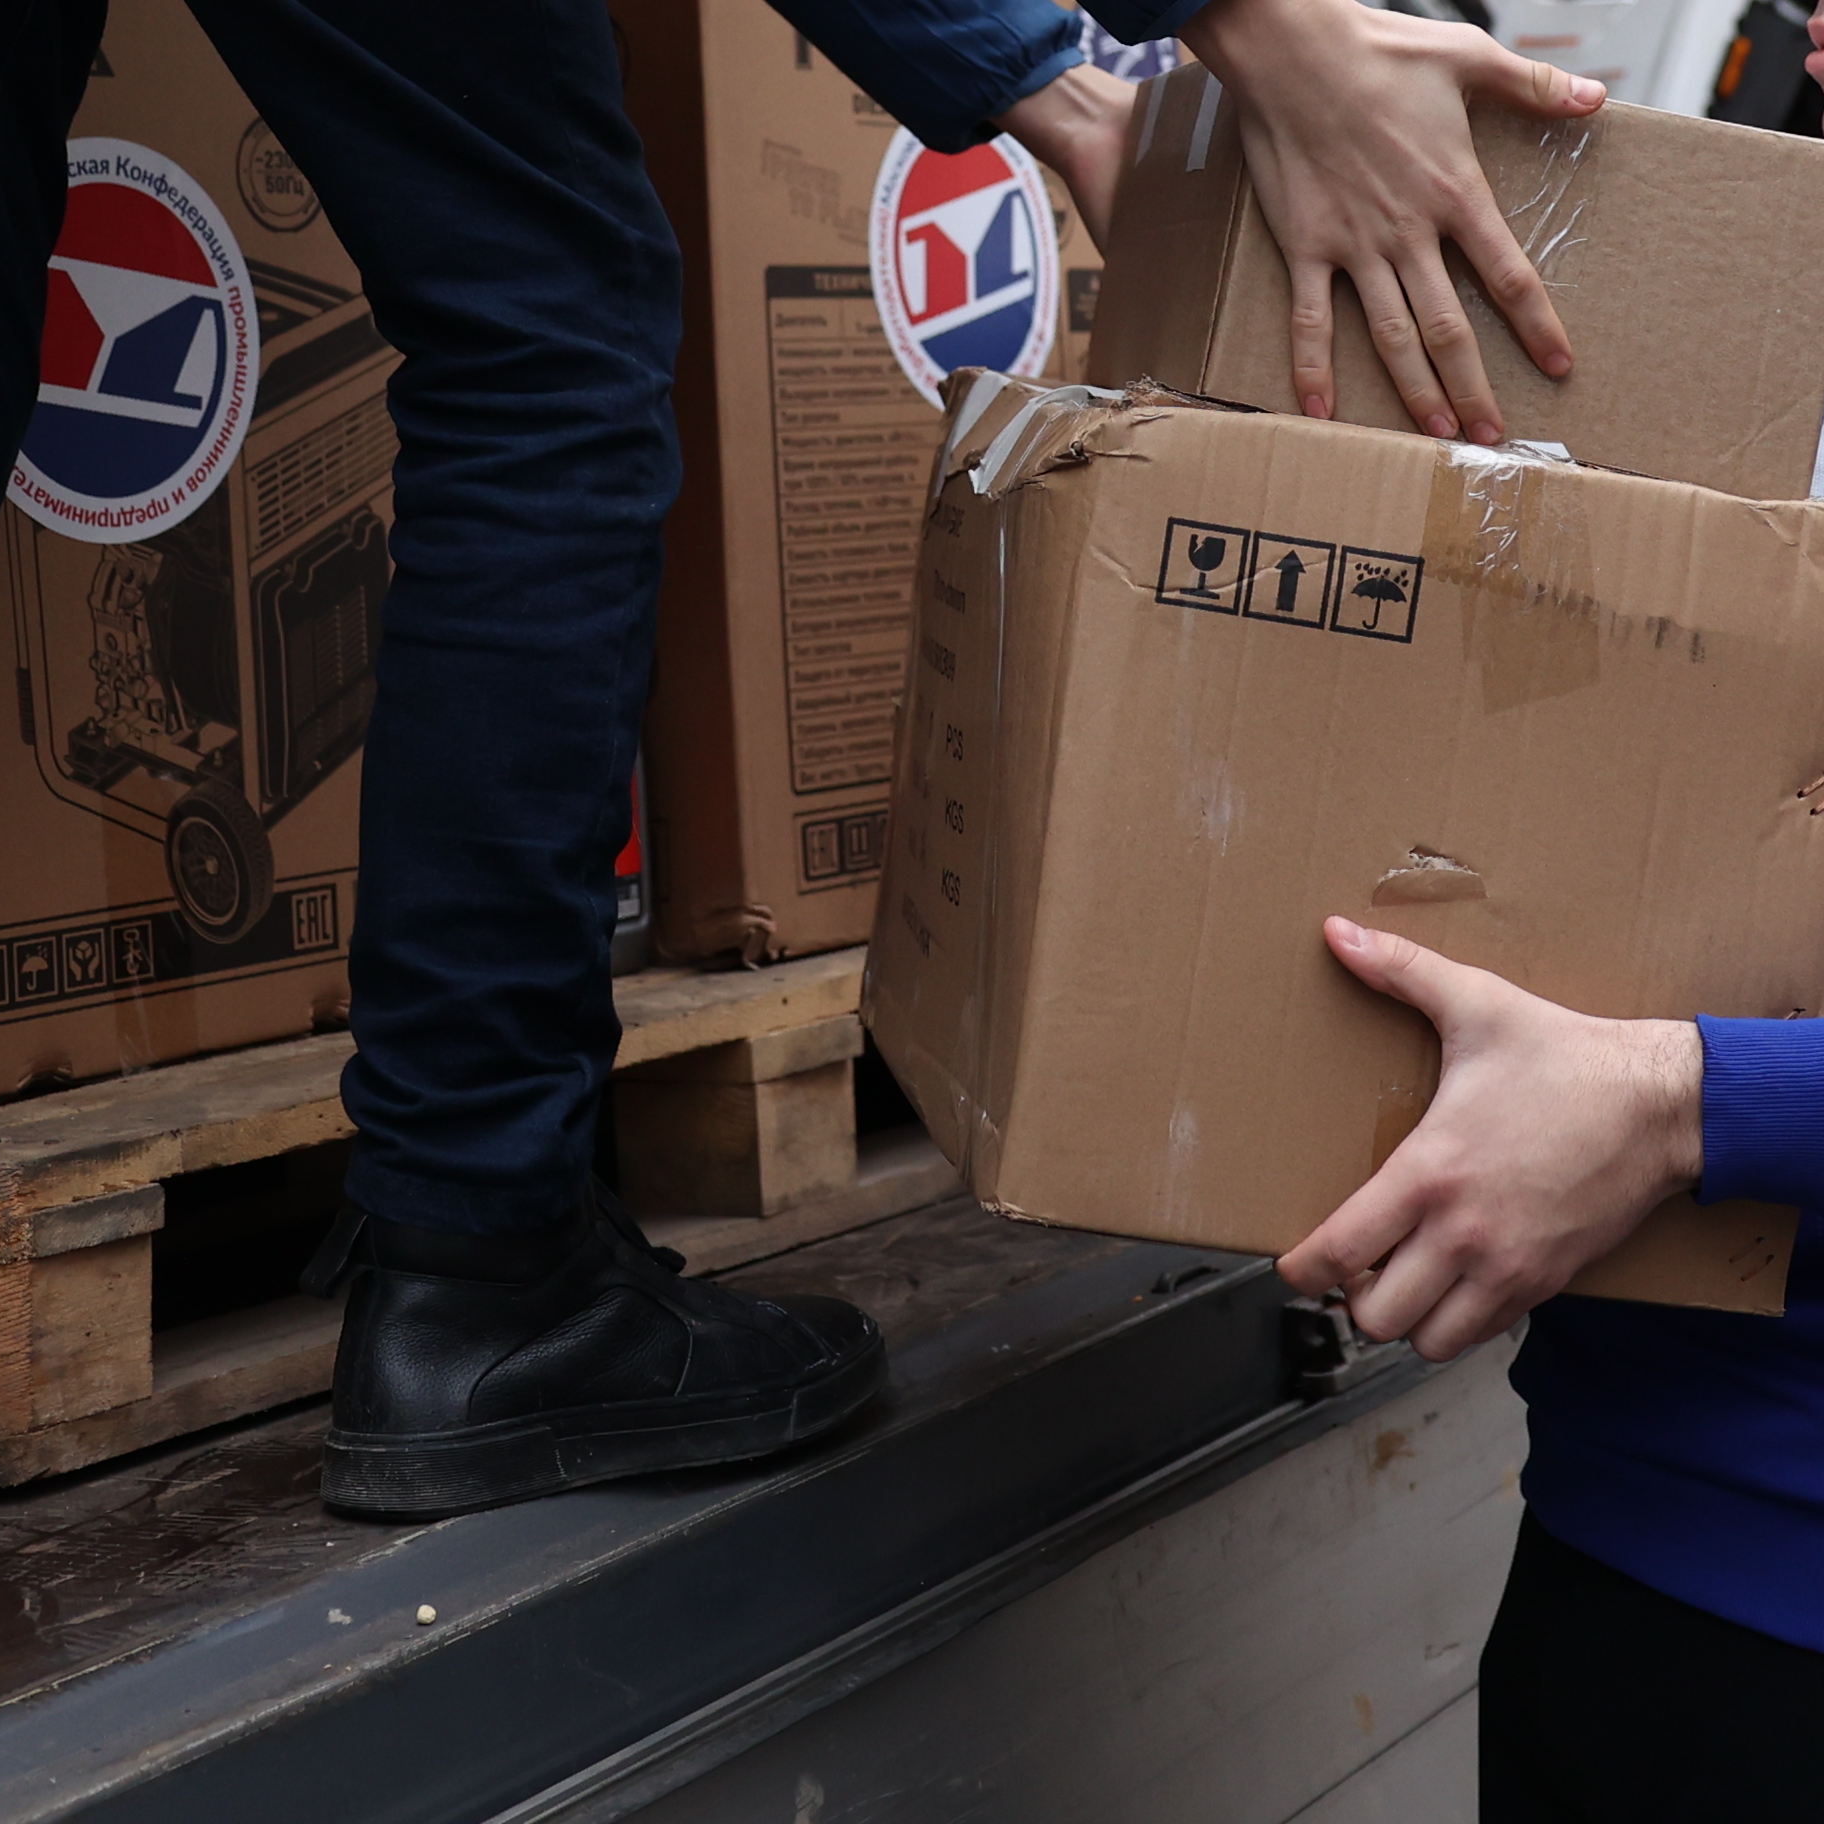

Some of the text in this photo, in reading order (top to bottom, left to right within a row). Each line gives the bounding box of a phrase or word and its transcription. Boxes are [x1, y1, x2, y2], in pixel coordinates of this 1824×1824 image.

[116, 155, 235, 282] Конфедерация
[13, 286, 249, 529] промышленников и предпринимате
[945, 796, 964, 835] KGS
[941, 867, 961, 907] KGS
